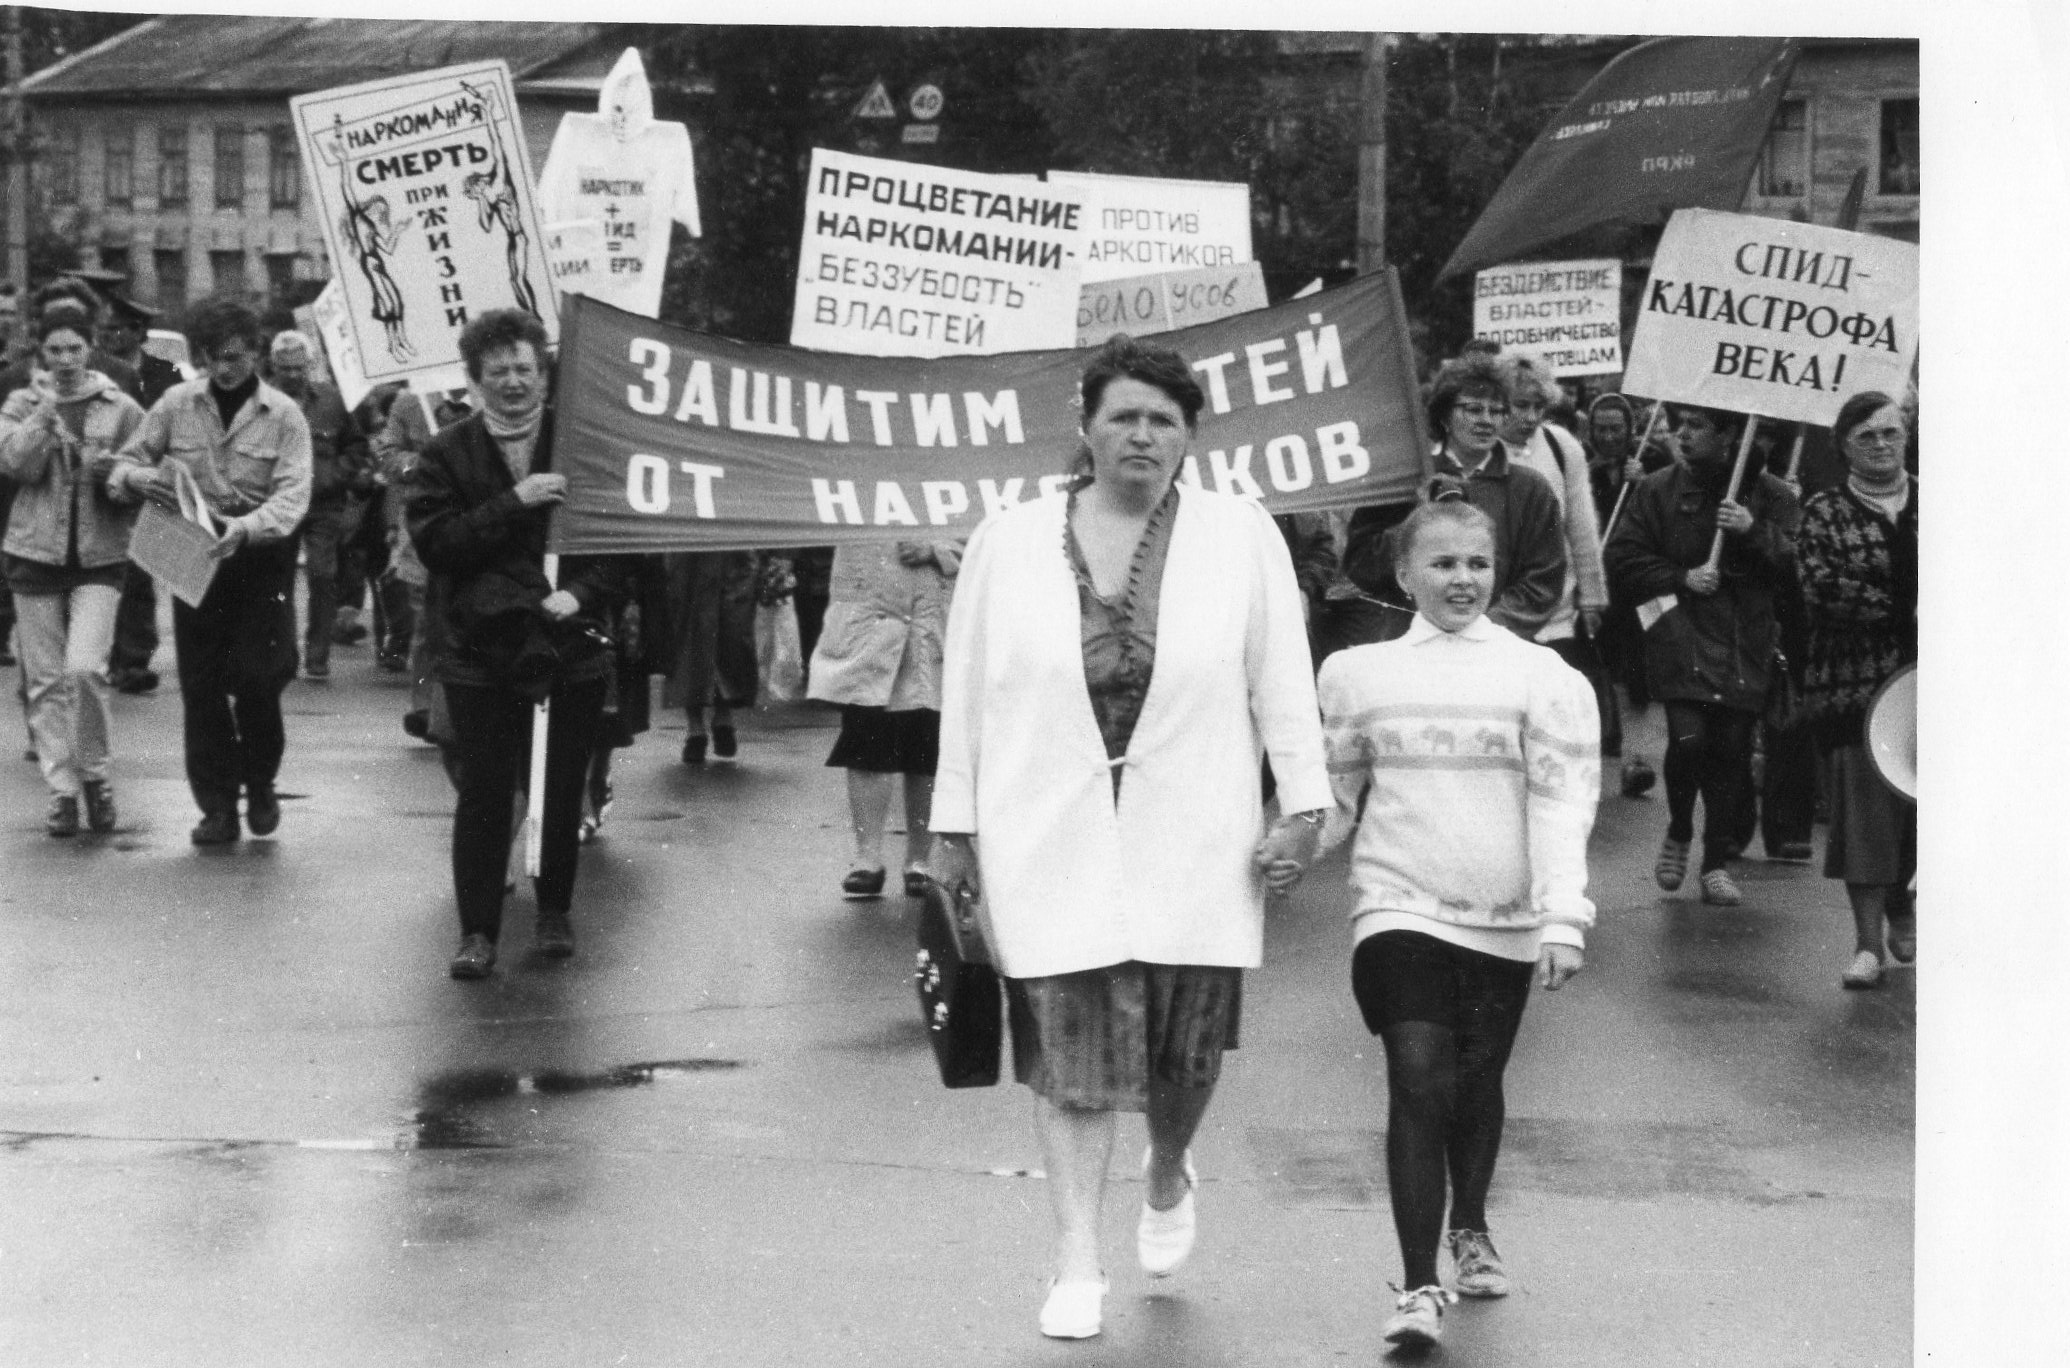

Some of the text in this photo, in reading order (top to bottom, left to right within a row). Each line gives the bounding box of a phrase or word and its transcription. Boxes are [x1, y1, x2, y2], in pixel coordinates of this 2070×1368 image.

[347, 97, 483, 149] НАРКОМАНИЯ
[356, 143, 488, 185] СМЕРТЬ
[405, 184, 449, 204] ПРИ
[818, 167, 1081, 231] ПРОЦВЕТАНИЕ
[815, 210, 1076, 270] НАРКОМАНИИ-
[1102, 208, 1199, 234] ПРОТИВ
[610, 257, 644, 274] ЕРТЬ
[1088, 240, 1235, 267] АРКОТИКОВ
[1734, 242, 1872, 293] СПИД-
[1477, 268, 1613, 299] БЕЗДЕЙСТВИЕ
[815, 295, 986, 348] ВЛАСТЕЙ
[1647, 278, 1899, 354] КАТАСТРОФА
[627, 312, 1349, 448] ЗАЩИТИМ ТЕЙ
[1712, 341, 1847, 393] ВЕКА!
[627, 420, 1371, 525] ОТ НАРККОВ
